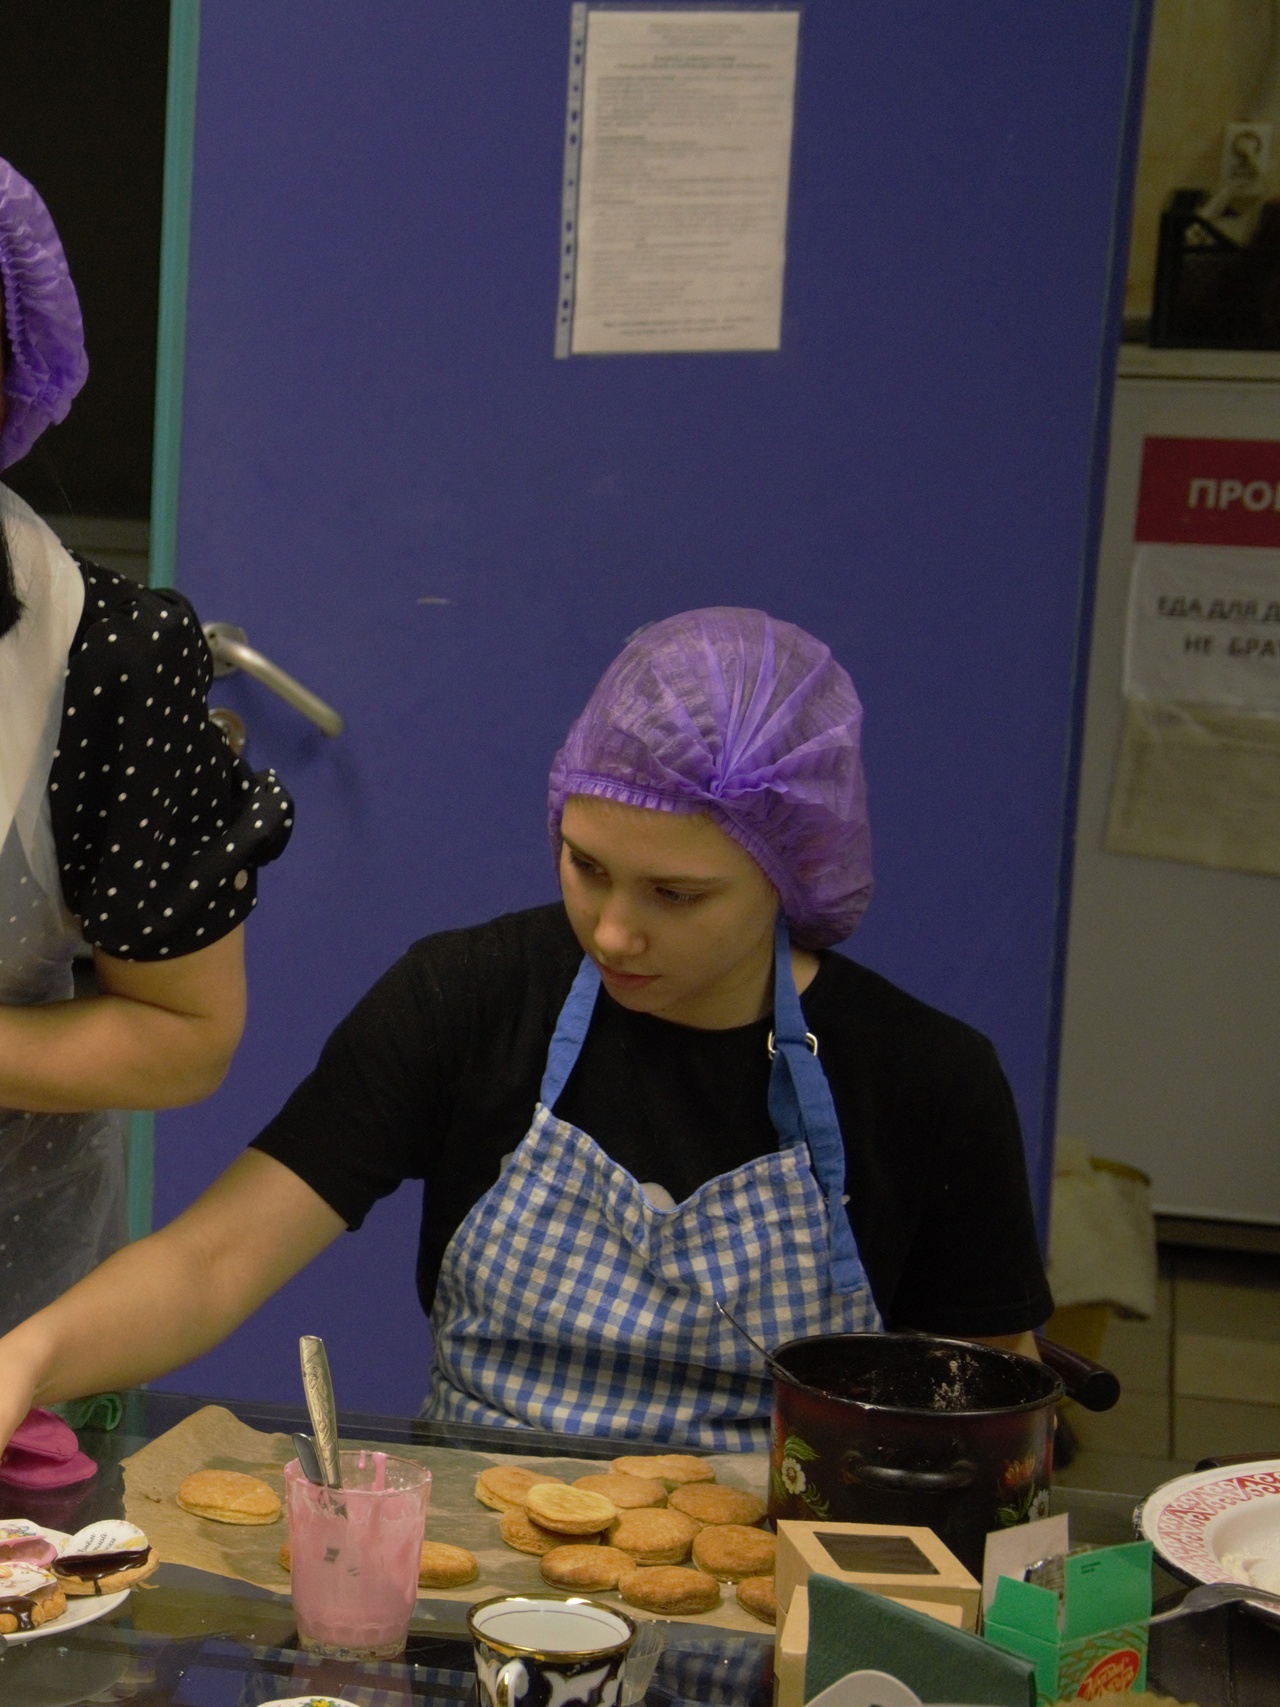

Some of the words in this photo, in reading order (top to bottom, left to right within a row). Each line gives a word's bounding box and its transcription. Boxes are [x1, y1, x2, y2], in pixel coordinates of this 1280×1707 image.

[1188, 478, 1280, 512] ПРО
[1156, 595, 1204, 617] ЕДА
[1207, 598, 1258, 620] ДЛЯ
[1184, 632, 1213, 653] НЕ
[1228, 637, 1280, 657] БРА
